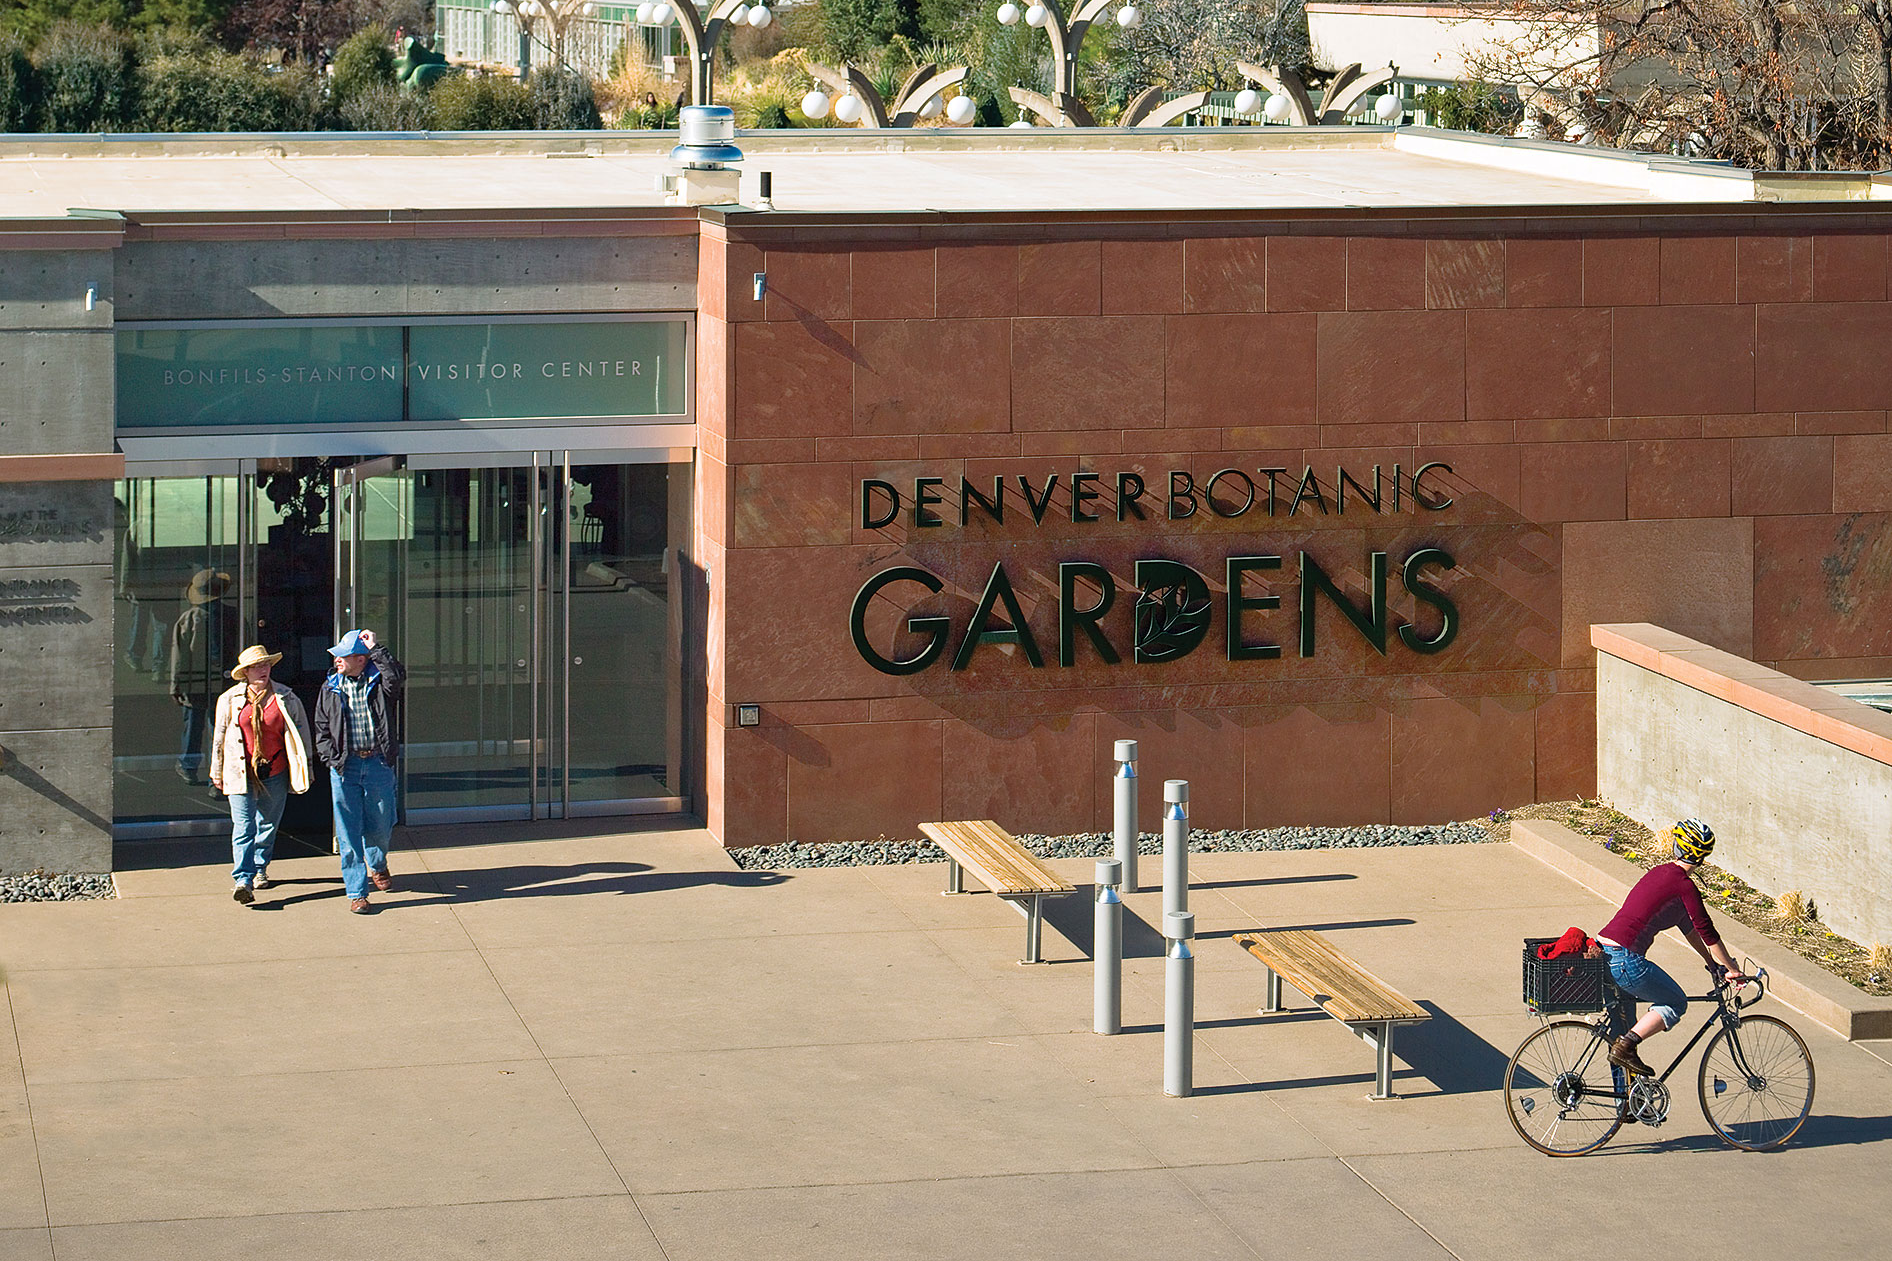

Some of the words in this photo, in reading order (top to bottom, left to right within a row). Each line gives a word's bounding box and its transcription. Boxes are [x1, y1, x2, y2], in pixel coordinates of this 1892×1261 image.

[163, 365, 396, 386] BONFILS-STANTON
[417, 362, 523, 380] VISITOR
[541, 360, 642, 378] CENTER
[861, 471, 1146, 530] DENVER
[1167, 461, 1456, 520] BOTANIC
[848, 547, 1460, 677] GARDENS
